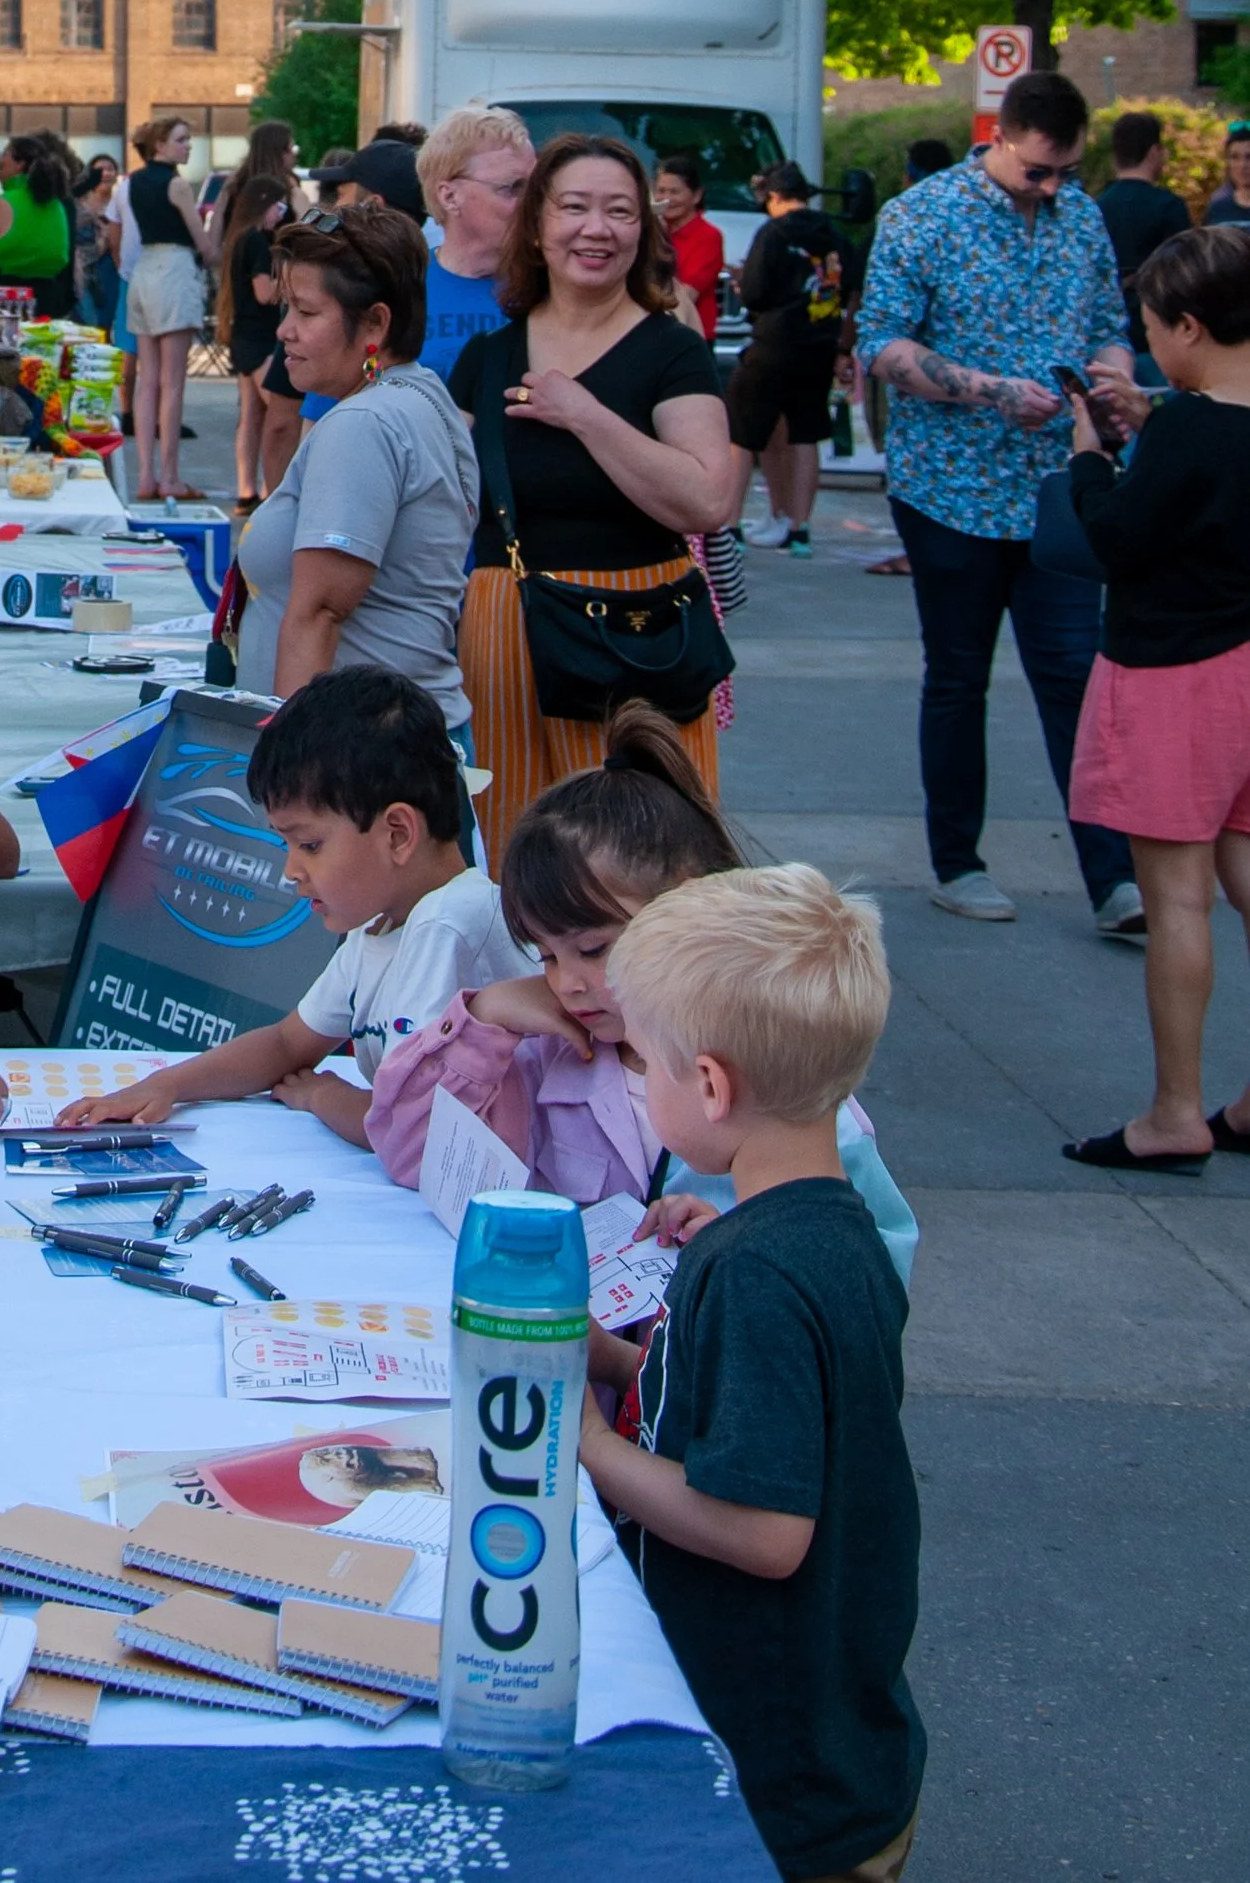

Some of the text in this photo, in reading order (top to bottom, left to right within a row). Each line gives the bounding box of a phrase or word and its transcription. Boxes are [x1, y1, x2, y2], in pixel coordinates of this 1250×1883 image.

[141, 824, 299, 896] ET MOBILE
[98, 973, 152, 1023] FULL
[469, 1316, 495, 1332] BOTTLE
[496, 1322, 524, 1336] MADE
[525, 1325, 552, 1337] FROM
[544, 1379, 565, 1498] HYDRATION
[470, 1375, 546, 1652] core
[455, 1653, 501, 1675] perfectly
[503, 1659, 555, 1674] balanced
[485, 1691, 519, 1703] water
[492, 1676, 539, 1689] purified
